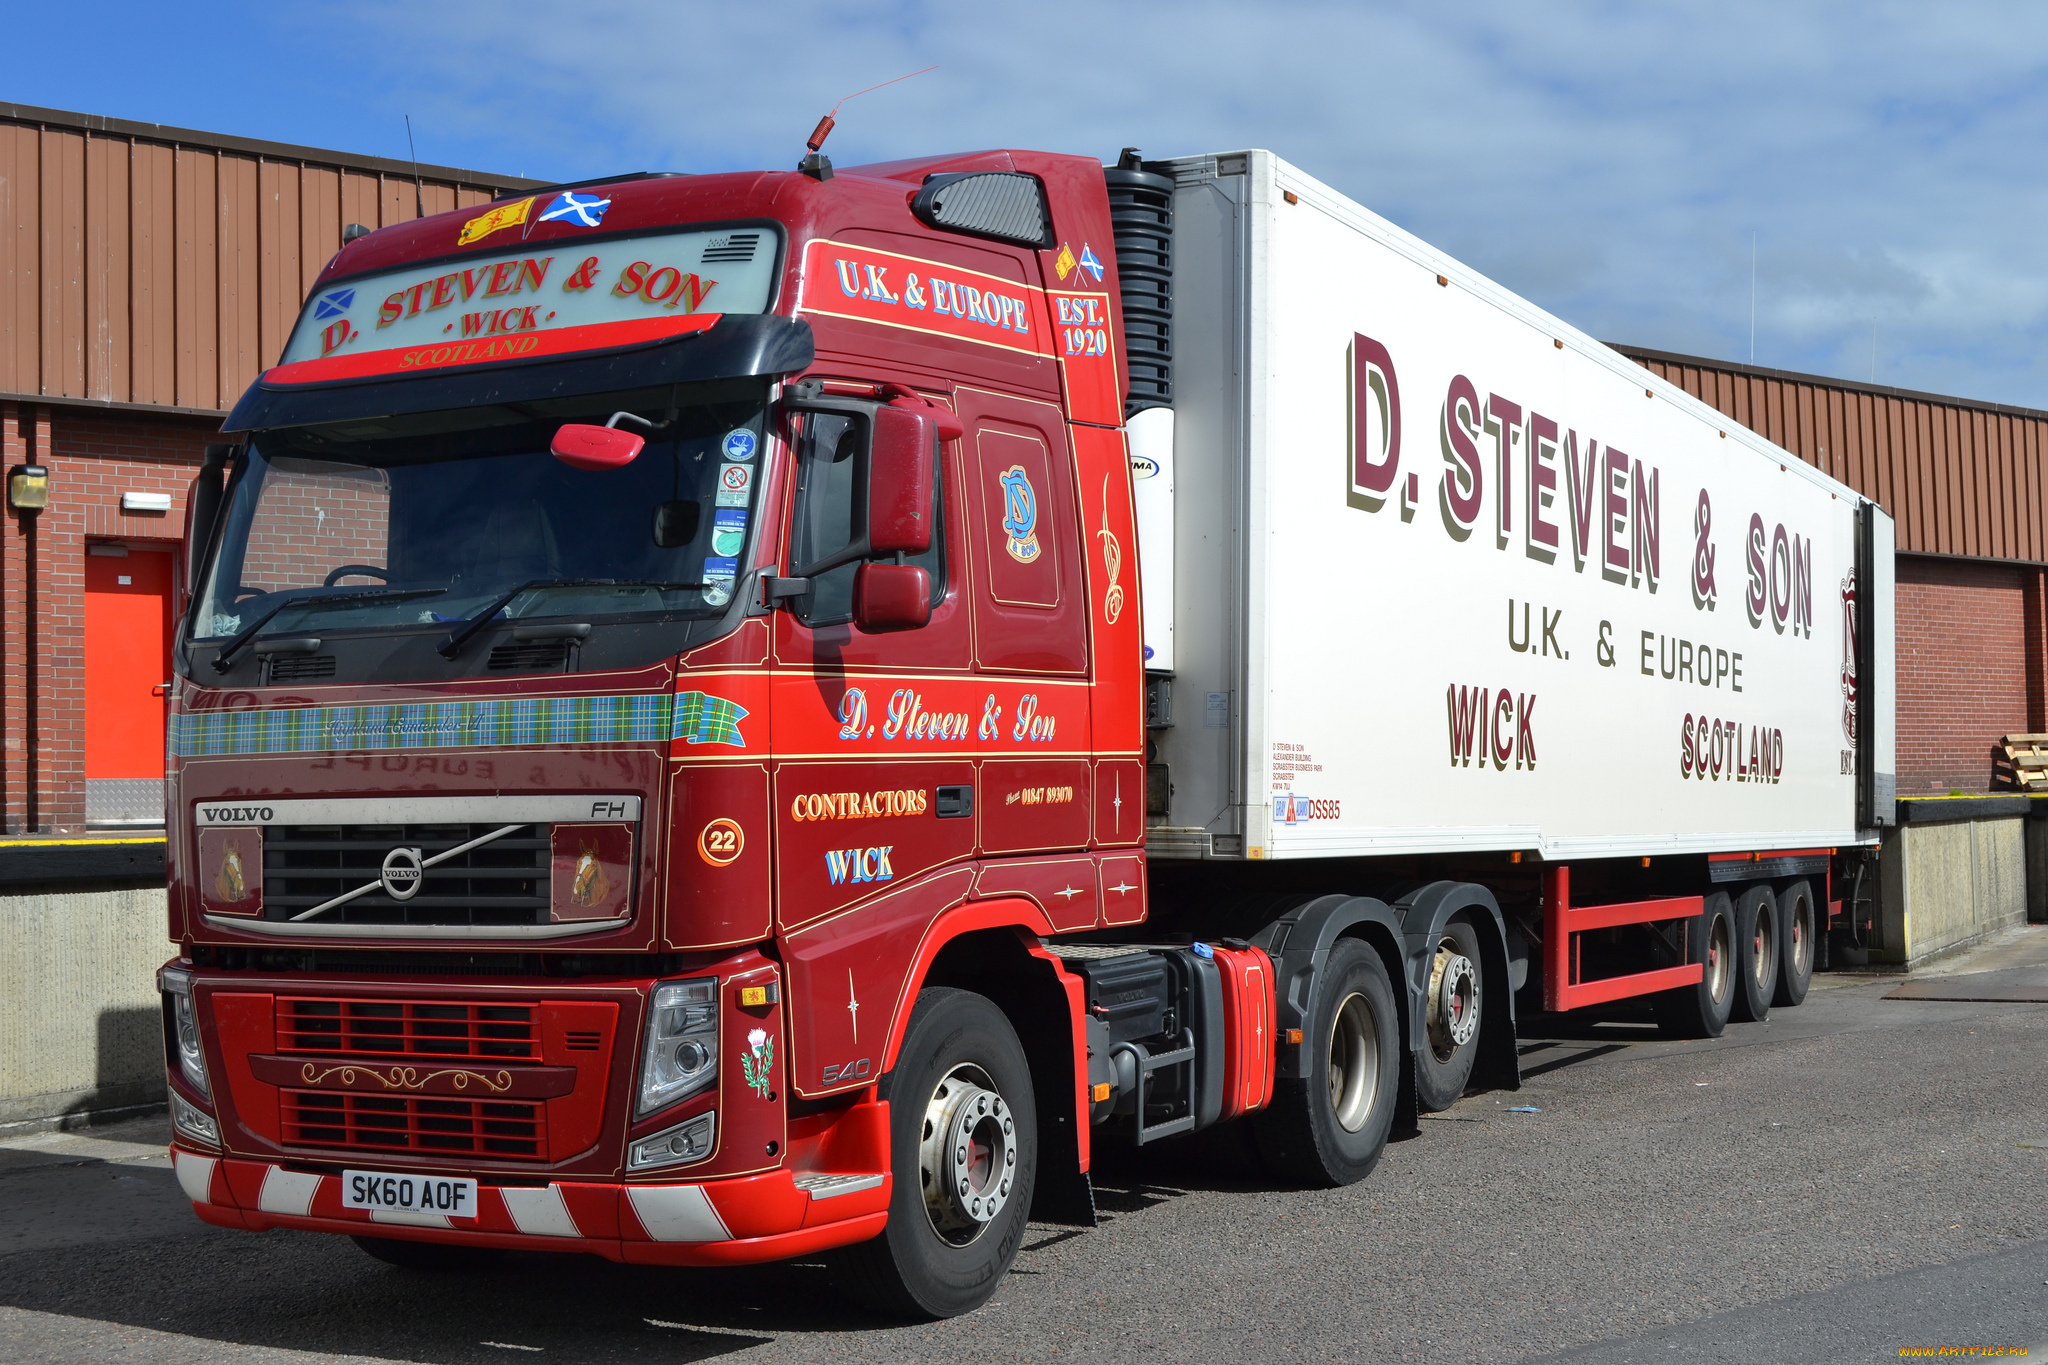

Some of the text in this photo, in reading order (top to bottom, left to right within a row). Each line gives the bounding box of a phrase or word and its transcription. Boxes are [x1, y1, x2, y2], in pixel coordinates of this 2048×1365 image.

[320, 256, 719, 359] D. STEVEN & SON
[835, 258, 1029, 333] U.K. & EUROPE
[1056, 297, 1104, 326] EST.
[398, 336, 538, 369] SCOTLAND
[1063, 328, 1107, 357] 1920
[1346, 331, 1812, 640] D. STEVEN & SON
[1021, 542, 1036, 557] SON
[1508, 598, 1743, 693] U.K. & EUROPE
[838, 687, 1056, 742] D. Steven & Son
[323, 717, 388, 742] Highland
[1446, 682, 1783, 785] WICK SCOTLAND
[1277, 743, 1291, 751] STEVEN
[590, 802, 626, 818] FH
[791, 788, 927, 822] CONTRACTORS
[1022, 788, 1044, 805] 01847
[1046, 786, 1073, 804] 893070
[1309, 799, 1340, 819] DSS85
[203, 807, 274, 822] VOLVO
[709, 831, 735, 852] 22
[384, 870, 420, 878] VOLVO
[824, 845, 894, 886] WICK
[822, 1058, 870, 1086] 540
[352, 1176, 467, 1210] SK60 AOF
